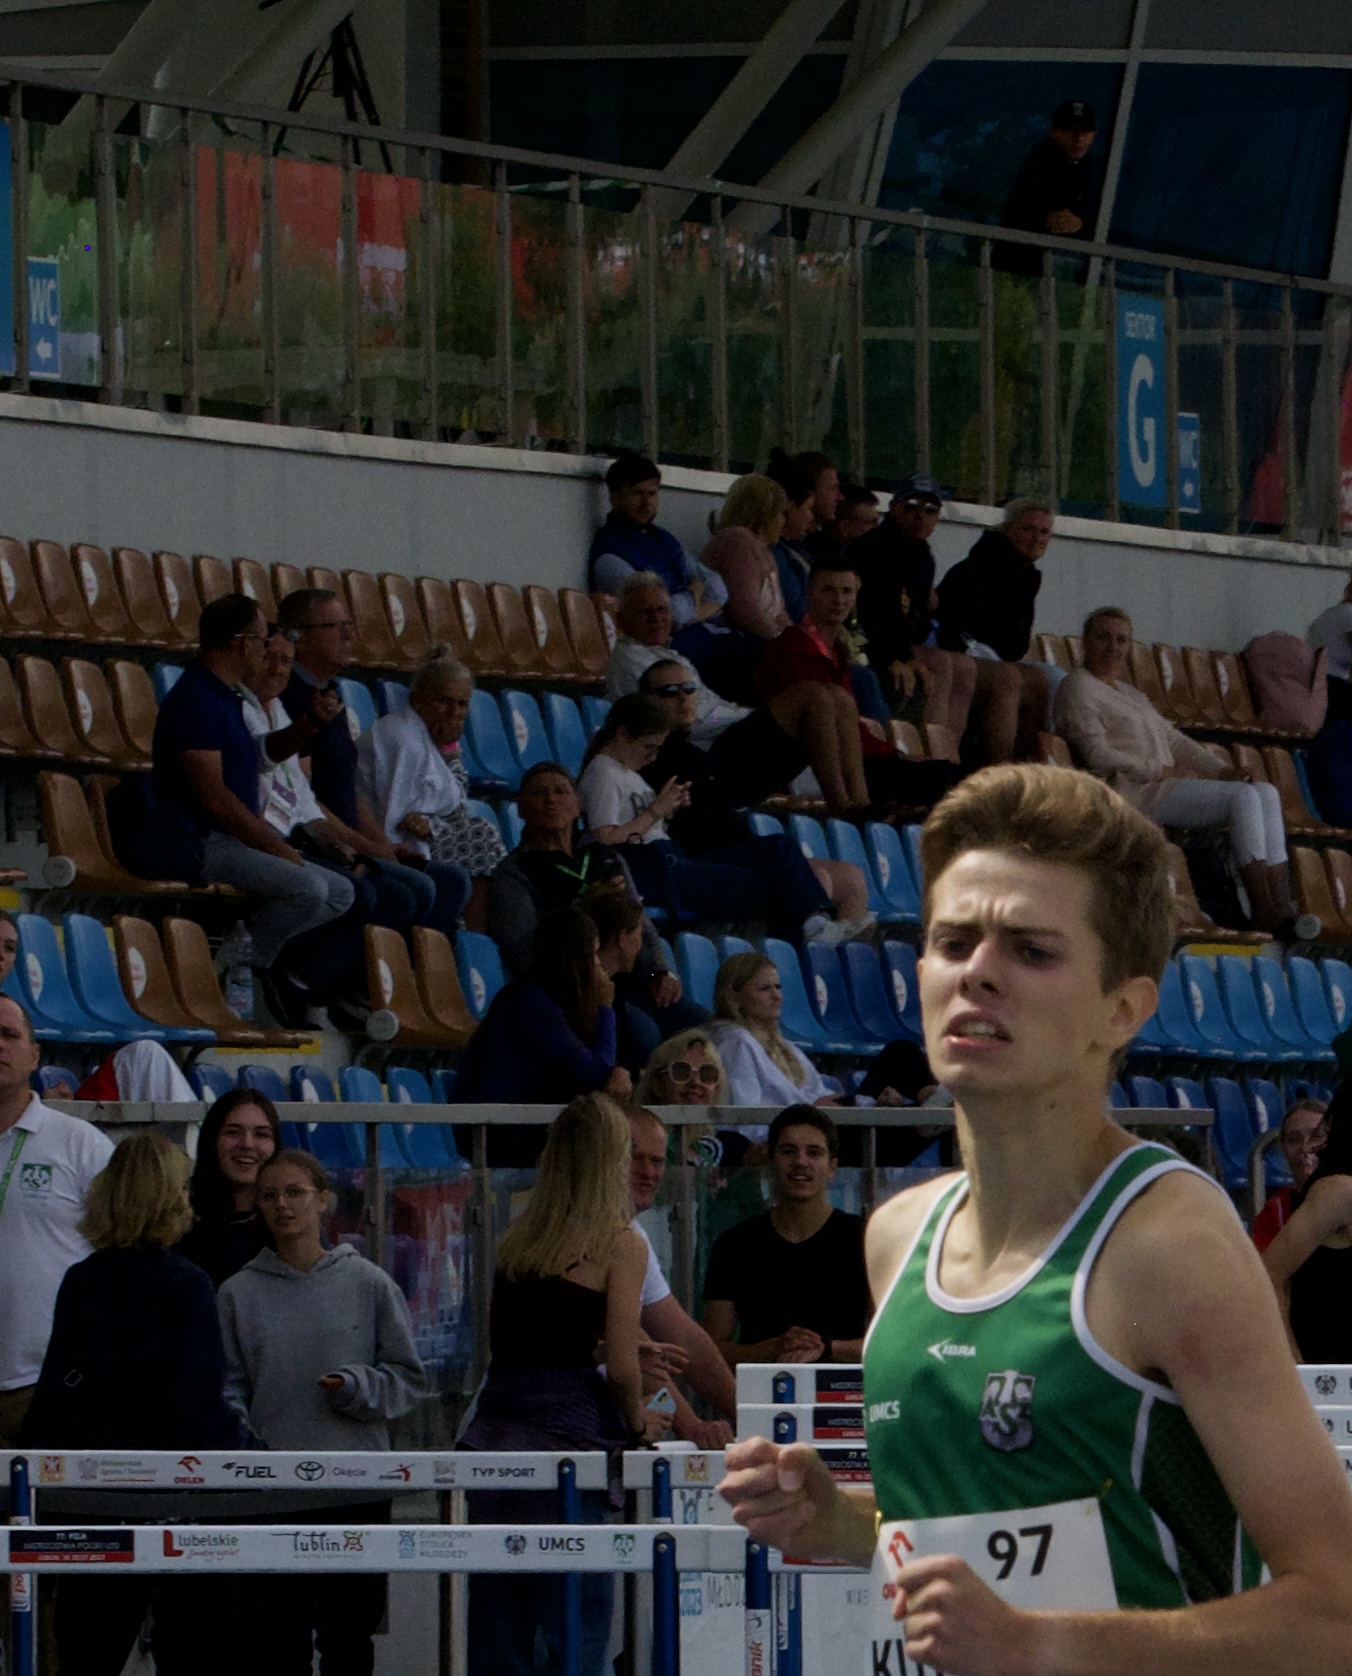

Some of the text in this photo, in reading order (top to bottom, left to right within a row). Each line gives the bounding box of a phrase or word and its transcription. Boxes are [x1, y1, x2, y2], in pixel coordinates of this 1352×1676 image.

[1128, 353, 1157, 488] G
[868, 1400, 900, 1423] UMCS
[234, 1466, 277, 1479] FUEL
[472, 1466, 536, 1478] TVP SPORT
[178, 1534, 239, 1547] lubelskie
[538, 1537, 586, 1552] UMCS
[987, 1523, 1054, 1581] 97
